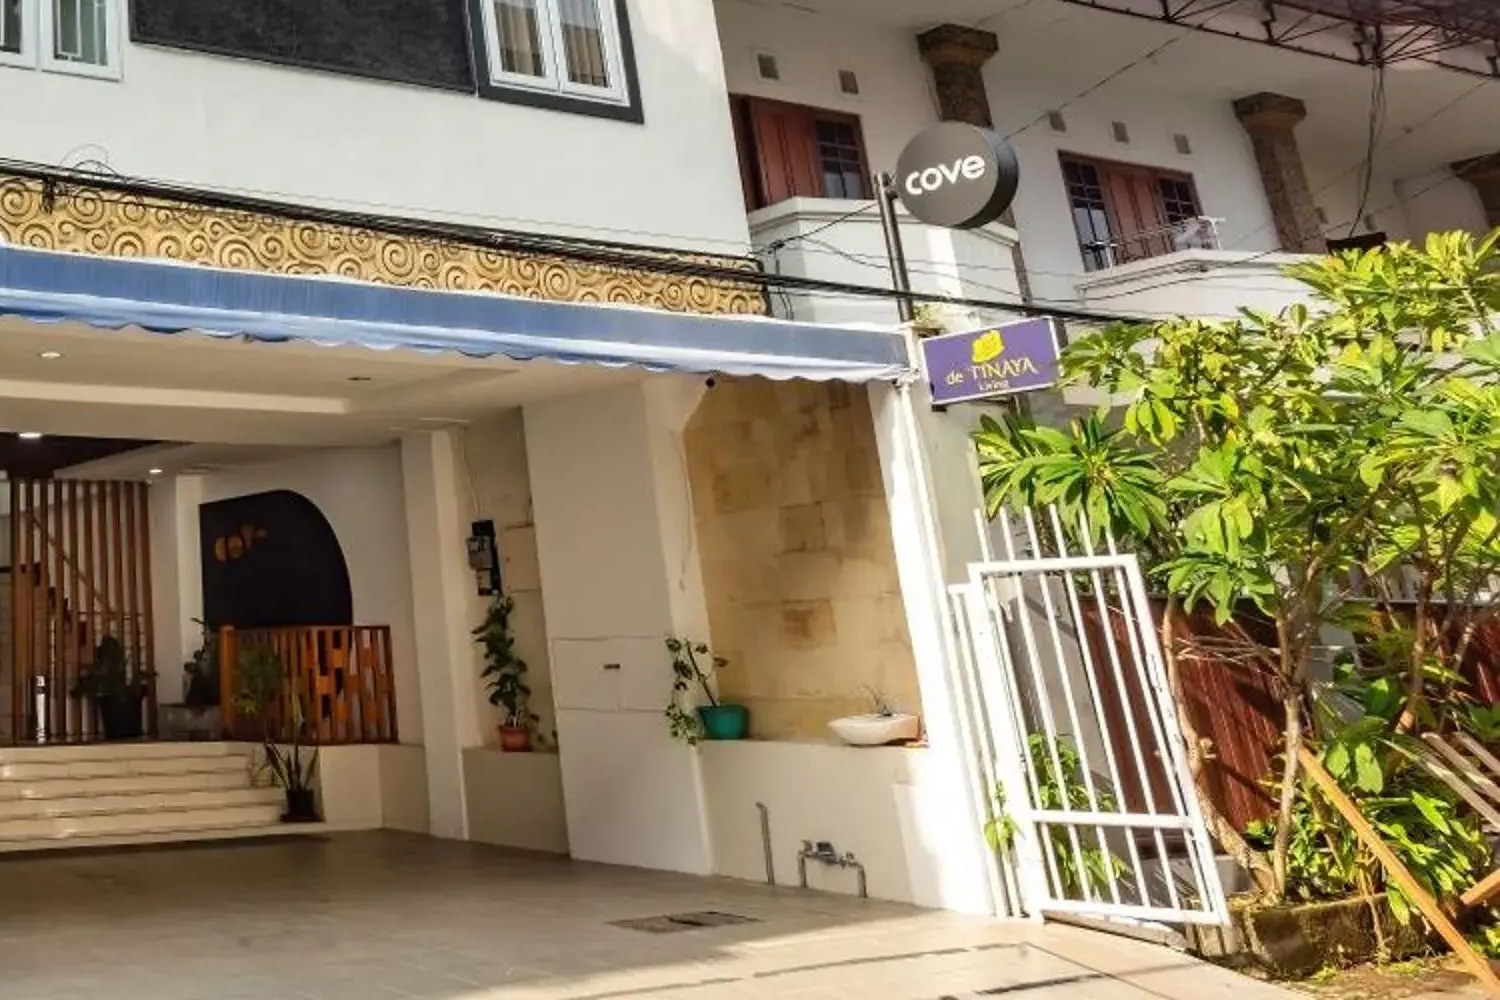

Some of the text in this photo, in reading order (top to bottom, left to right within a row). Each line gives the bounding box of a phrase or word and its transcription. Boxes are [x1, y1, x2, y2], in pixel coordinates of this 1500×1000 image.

[905, 155, 985, 195] cove
[946, 357, 1040, 386] de TINAYA
